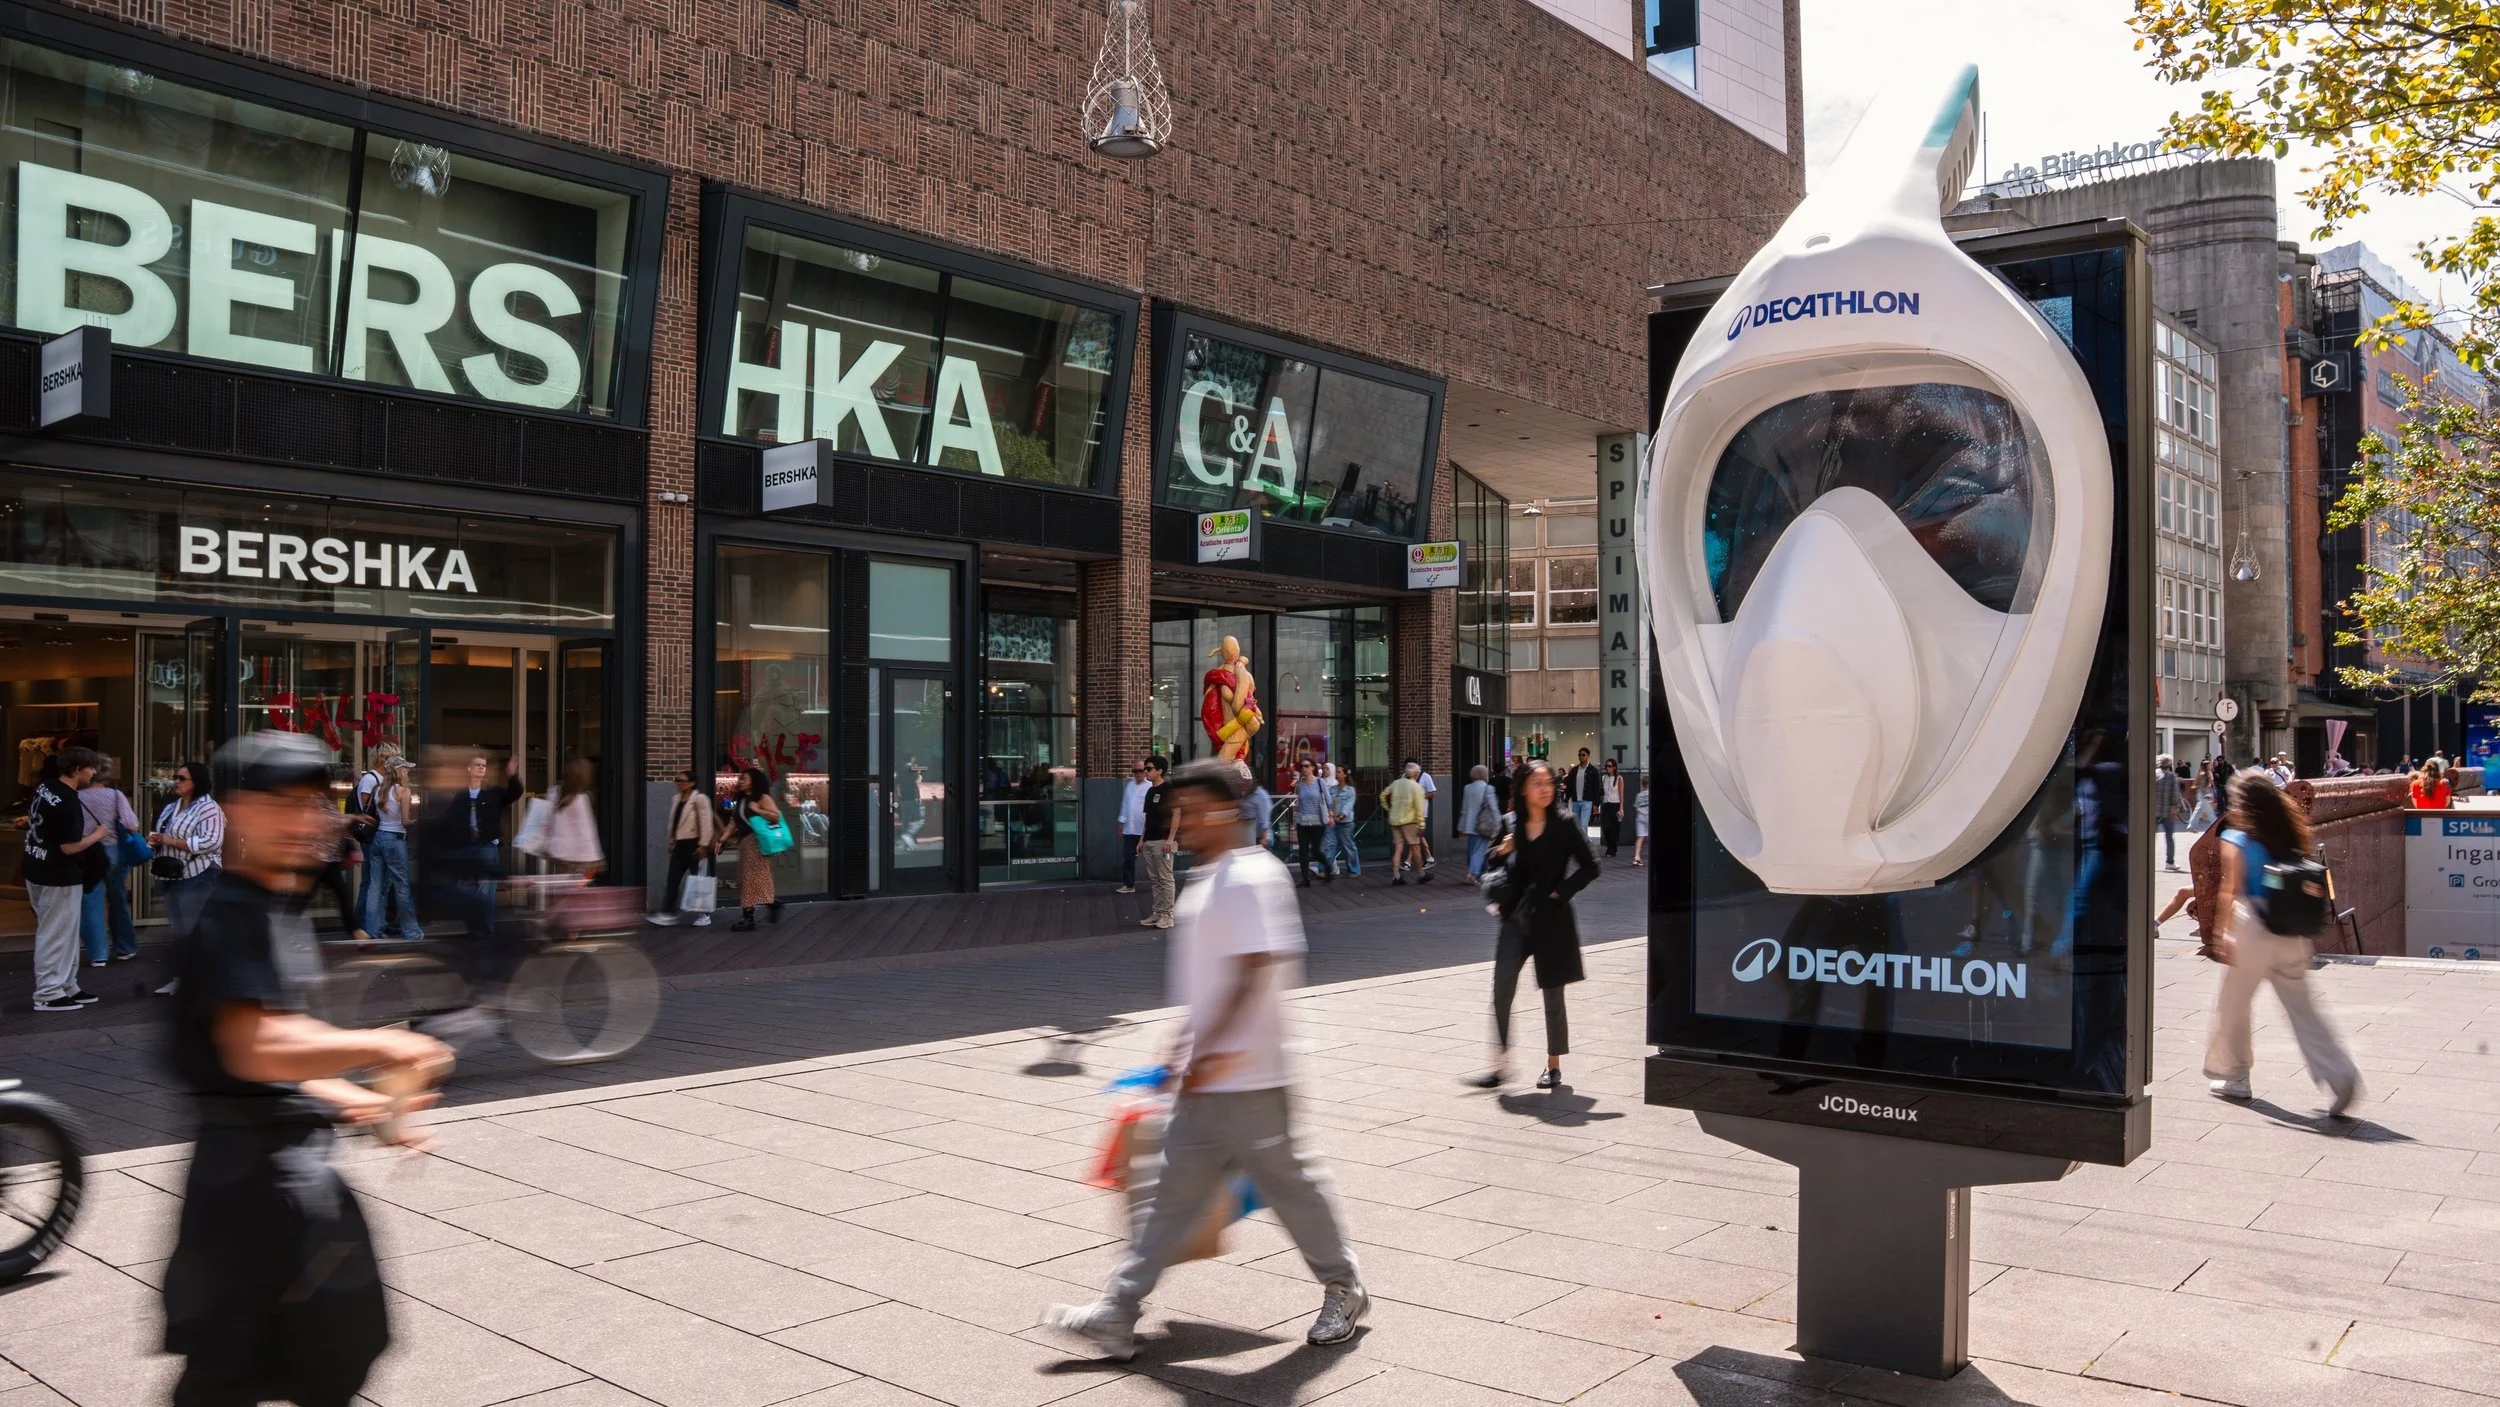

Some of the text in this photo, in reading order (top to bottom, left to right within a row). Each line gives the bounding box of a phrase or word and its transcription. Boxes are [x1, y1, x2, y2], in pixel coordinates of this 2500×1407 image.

[2002, 163, 2038, 185] de
[17, 161, 582, 410] BERS
[1752, 290, 1920, 328] DECATHLON
[43, 361, 83, 393] BERSHKA
[1179, 380, 1298, 498] C&A
[764, 465, 818, 488] BERSHKA
[1215, 524, 1244, 534] Oriental
[1223, 536, 1249, 545] supermarkt
[180, 526, 478, 593] BERSHKA
[1425, 554, 1453, 562] Oriental
[1608, 443, 1629, 764] SPUIMARKT
[1788, 946, 2027, 999] DECATHLON
[1818, 1095, 1919, 1122] JCDecaux
